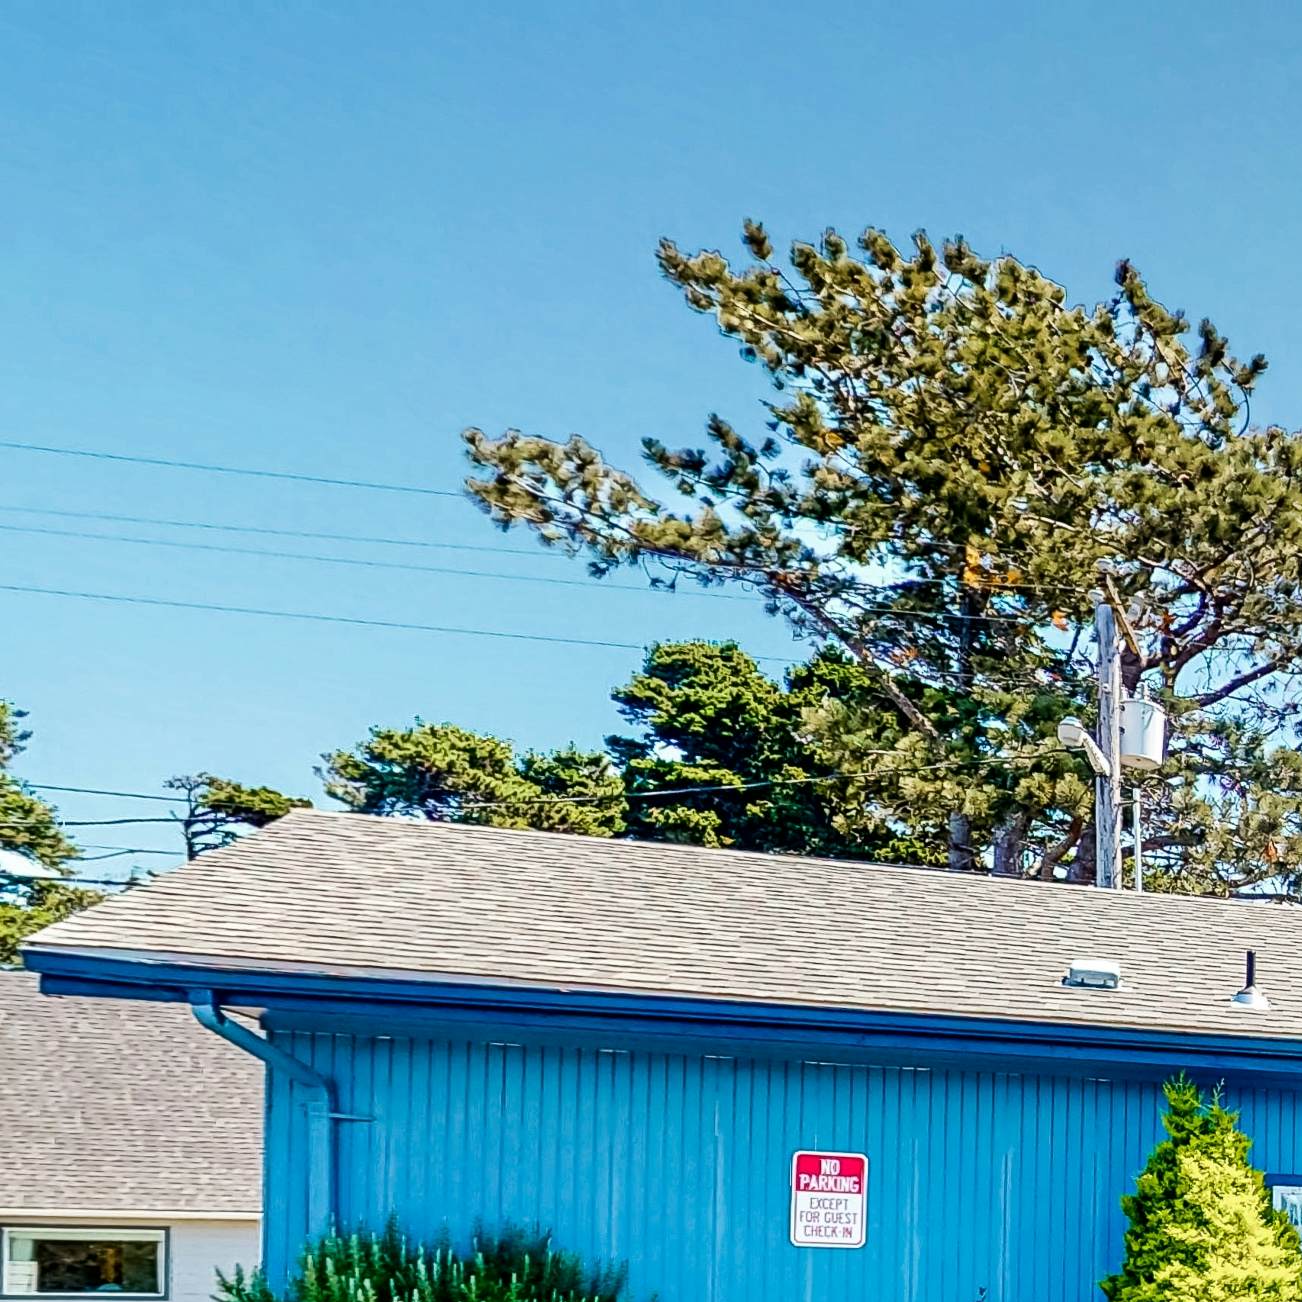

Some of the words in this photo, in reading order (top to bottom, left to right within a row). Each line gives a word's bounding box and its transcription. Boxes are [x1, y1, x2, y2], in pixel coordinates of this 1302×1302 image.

[820, 1158, 840, 1175] NO
[799, 1174, 859, 1192] PARKING
[809, 1197, 848, 1210] EXCEPT
[800, 1211, 820, 1222] FOR
[824, 1212, 857, 1224] GUEST
[804, 1225, 852, 1238] CHECK-IN
